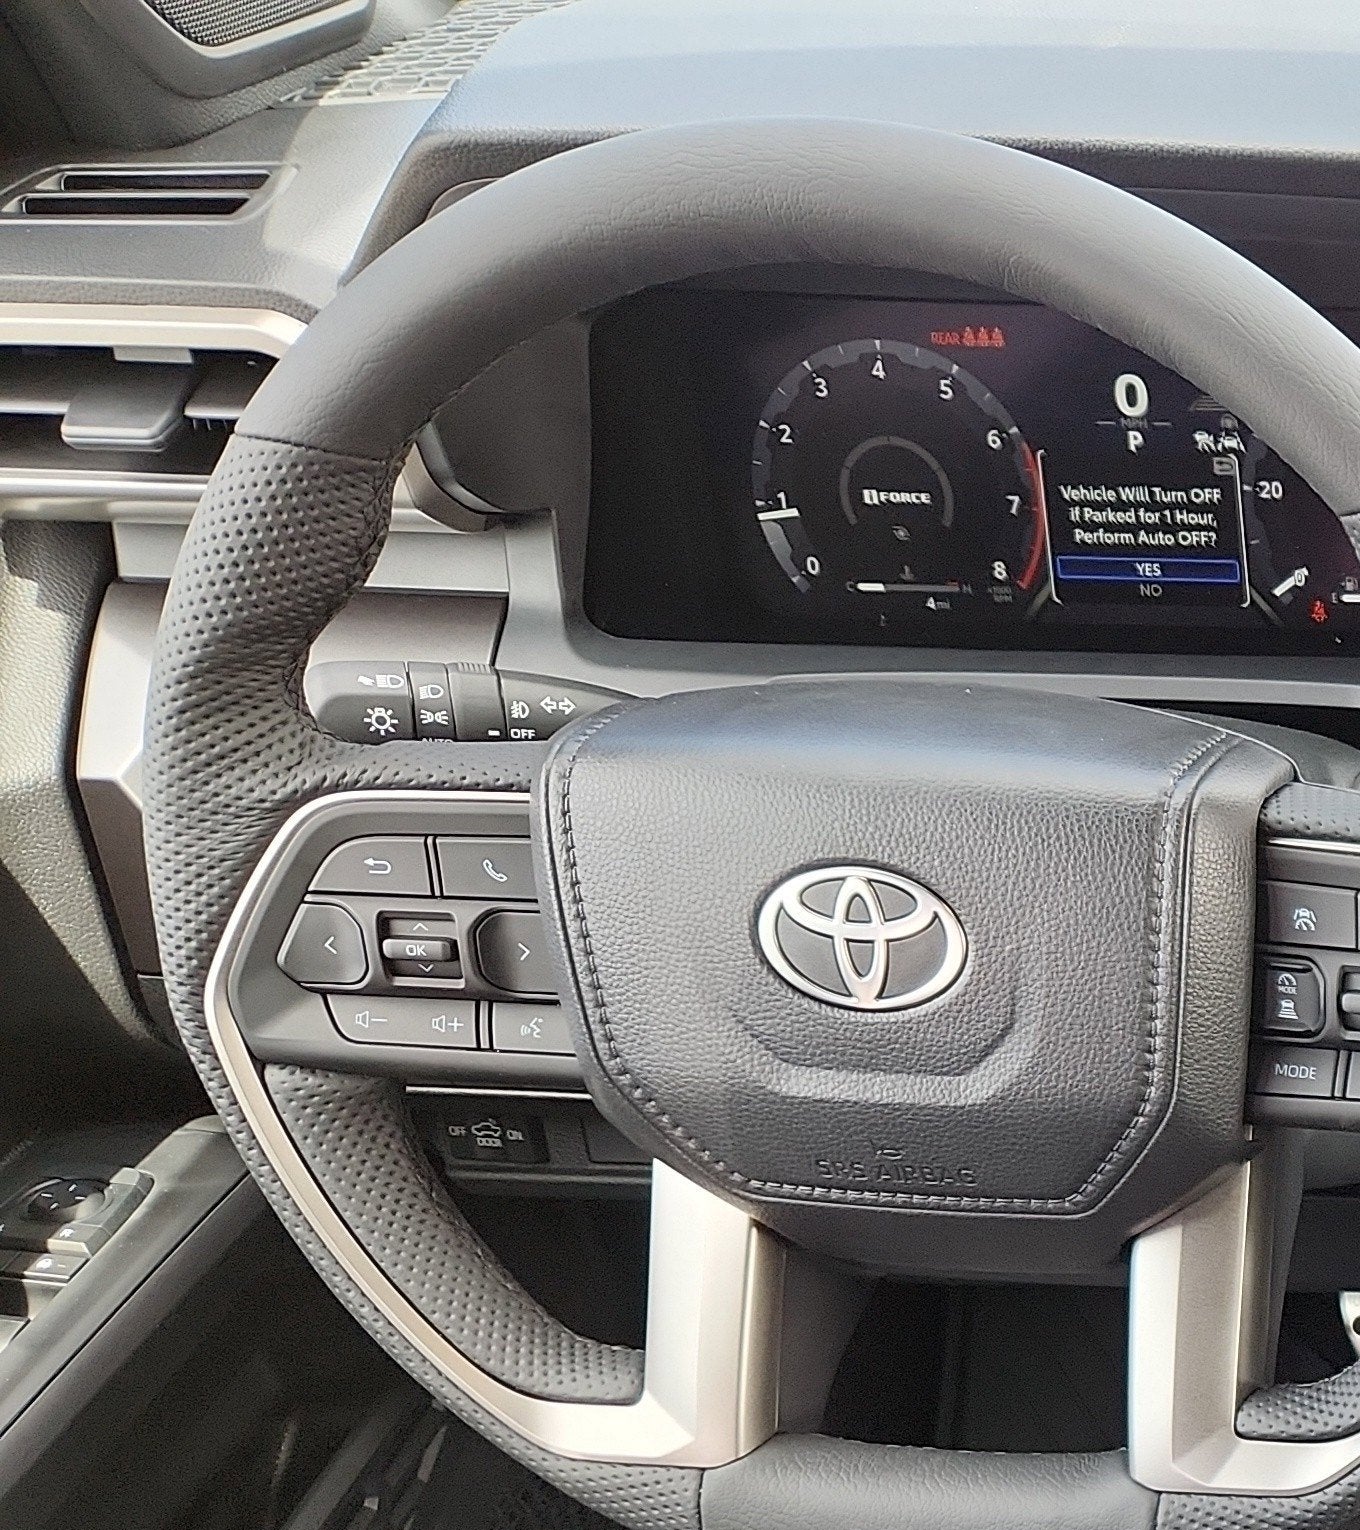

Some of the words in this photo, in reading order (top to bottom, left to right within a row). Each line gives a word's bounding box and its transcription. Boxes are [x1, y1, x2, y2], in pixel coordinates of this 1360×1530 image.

[871, 358, 885, 380] 4
[815, 377, 829, 398] 3
[939, 379, 954, 400] 5
[1115, 374, 1148, 417] 0
[778, 424, 795, 444] 2
[987, 429, 1002, 450] 6
[1127, 430, 1144, 455] P
[1059, 485, 1117, 502] Vehicle
[1118, 486, 1150, 502] Will
[1151, 487, 1187, 503] Turn
[1190, 488, 1221, 503] OFF
[1258, 481, 1283, 500] 20
[1006, 495, 1021, 516] 7
[1084, 508, 1136, 524] Parked
[1138, 508, 1161, 525] for
[1163, 510, 1171, 524] 1
[1074, 529, 1135, 546] Perform
[1137, 530, 1176, 546] Auto
[1178, 531, 1217, 548] OFF?
[806, 555, 820, 576] 0
[992, 560, 1008, 581] 8
[1135, 562, 1162, 577] YES
[1140, 583, 1163, 597] NO
[510, 728, 536, 740] OFF
[405, 944, 427, 957] OK
[1275, 1063, 1317, 1080] MODE
[448, 1126, 466, 1136] OFF
